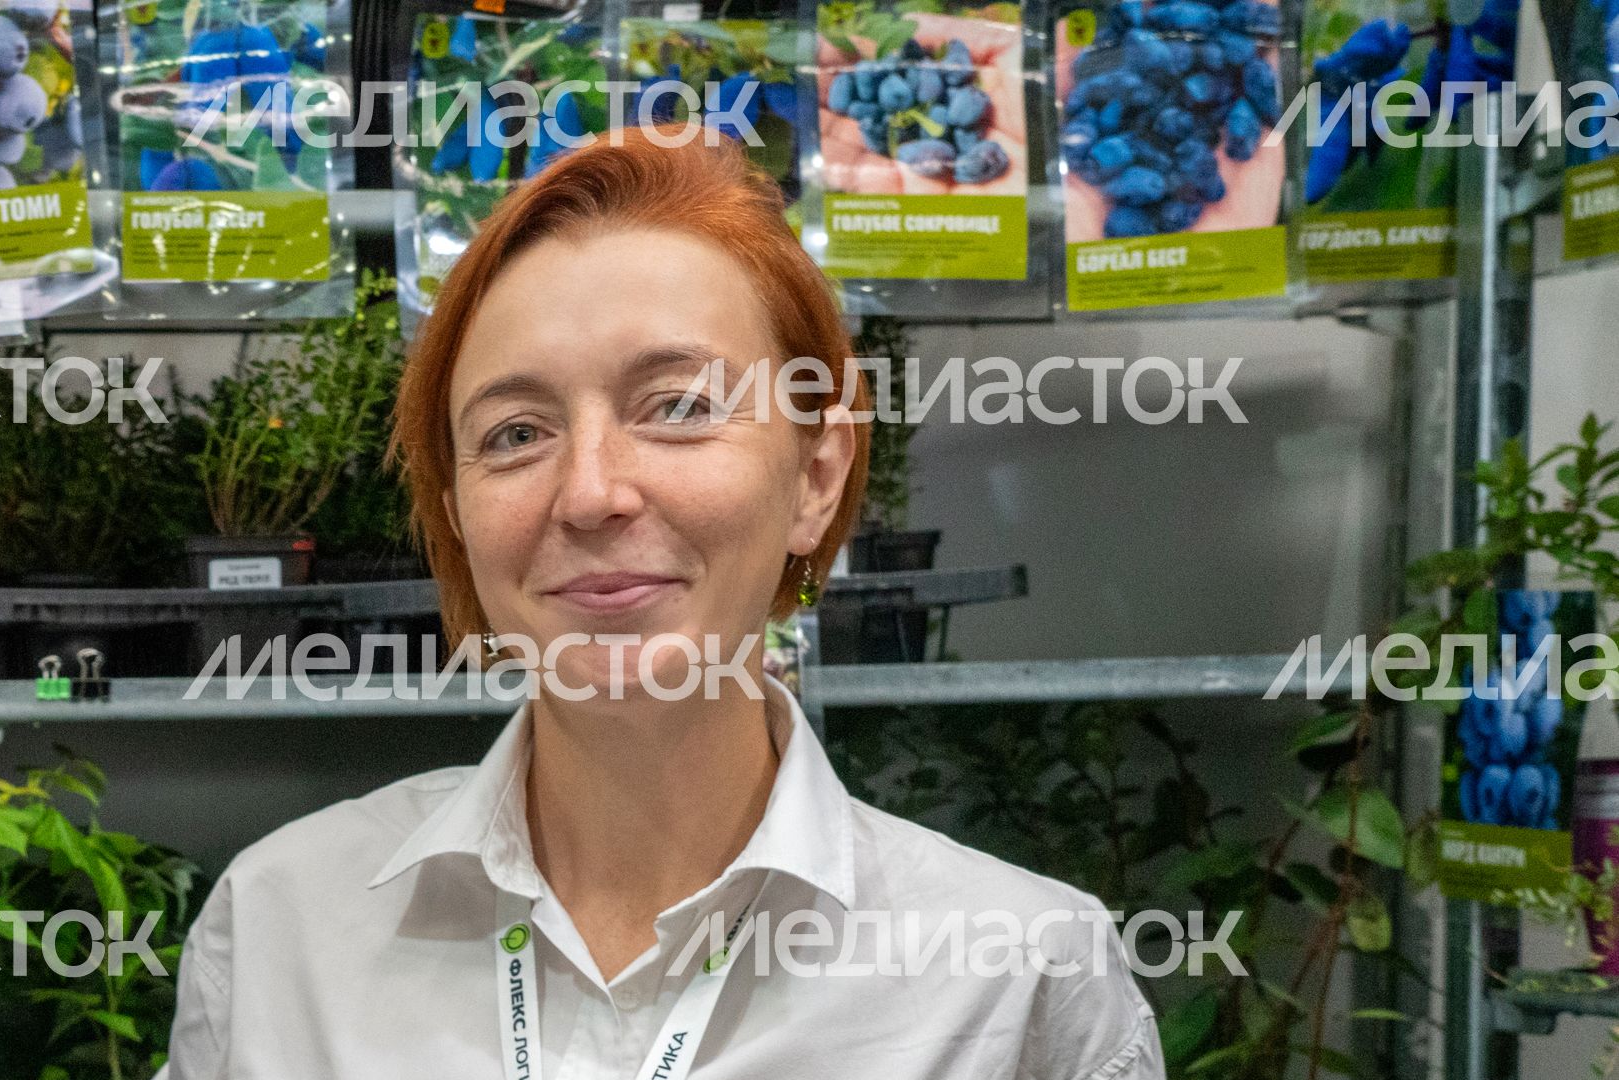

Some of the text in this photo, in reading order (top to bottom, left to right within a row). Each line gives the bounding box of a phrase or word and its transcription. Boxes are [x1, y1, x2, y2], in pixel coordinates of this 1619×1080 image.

[131, 210, 204, 232] ГОЛУБОЙ
[832, 214, 1000, 234] ГОЛУБОЕ СОКРОВИЩЕ
[1077, 252, 1143, 273] БОРЕАЛ
[1147, 247, 1187, 267] БЕСТ
[509, 958, 528, 1034] ФЛЕКС
